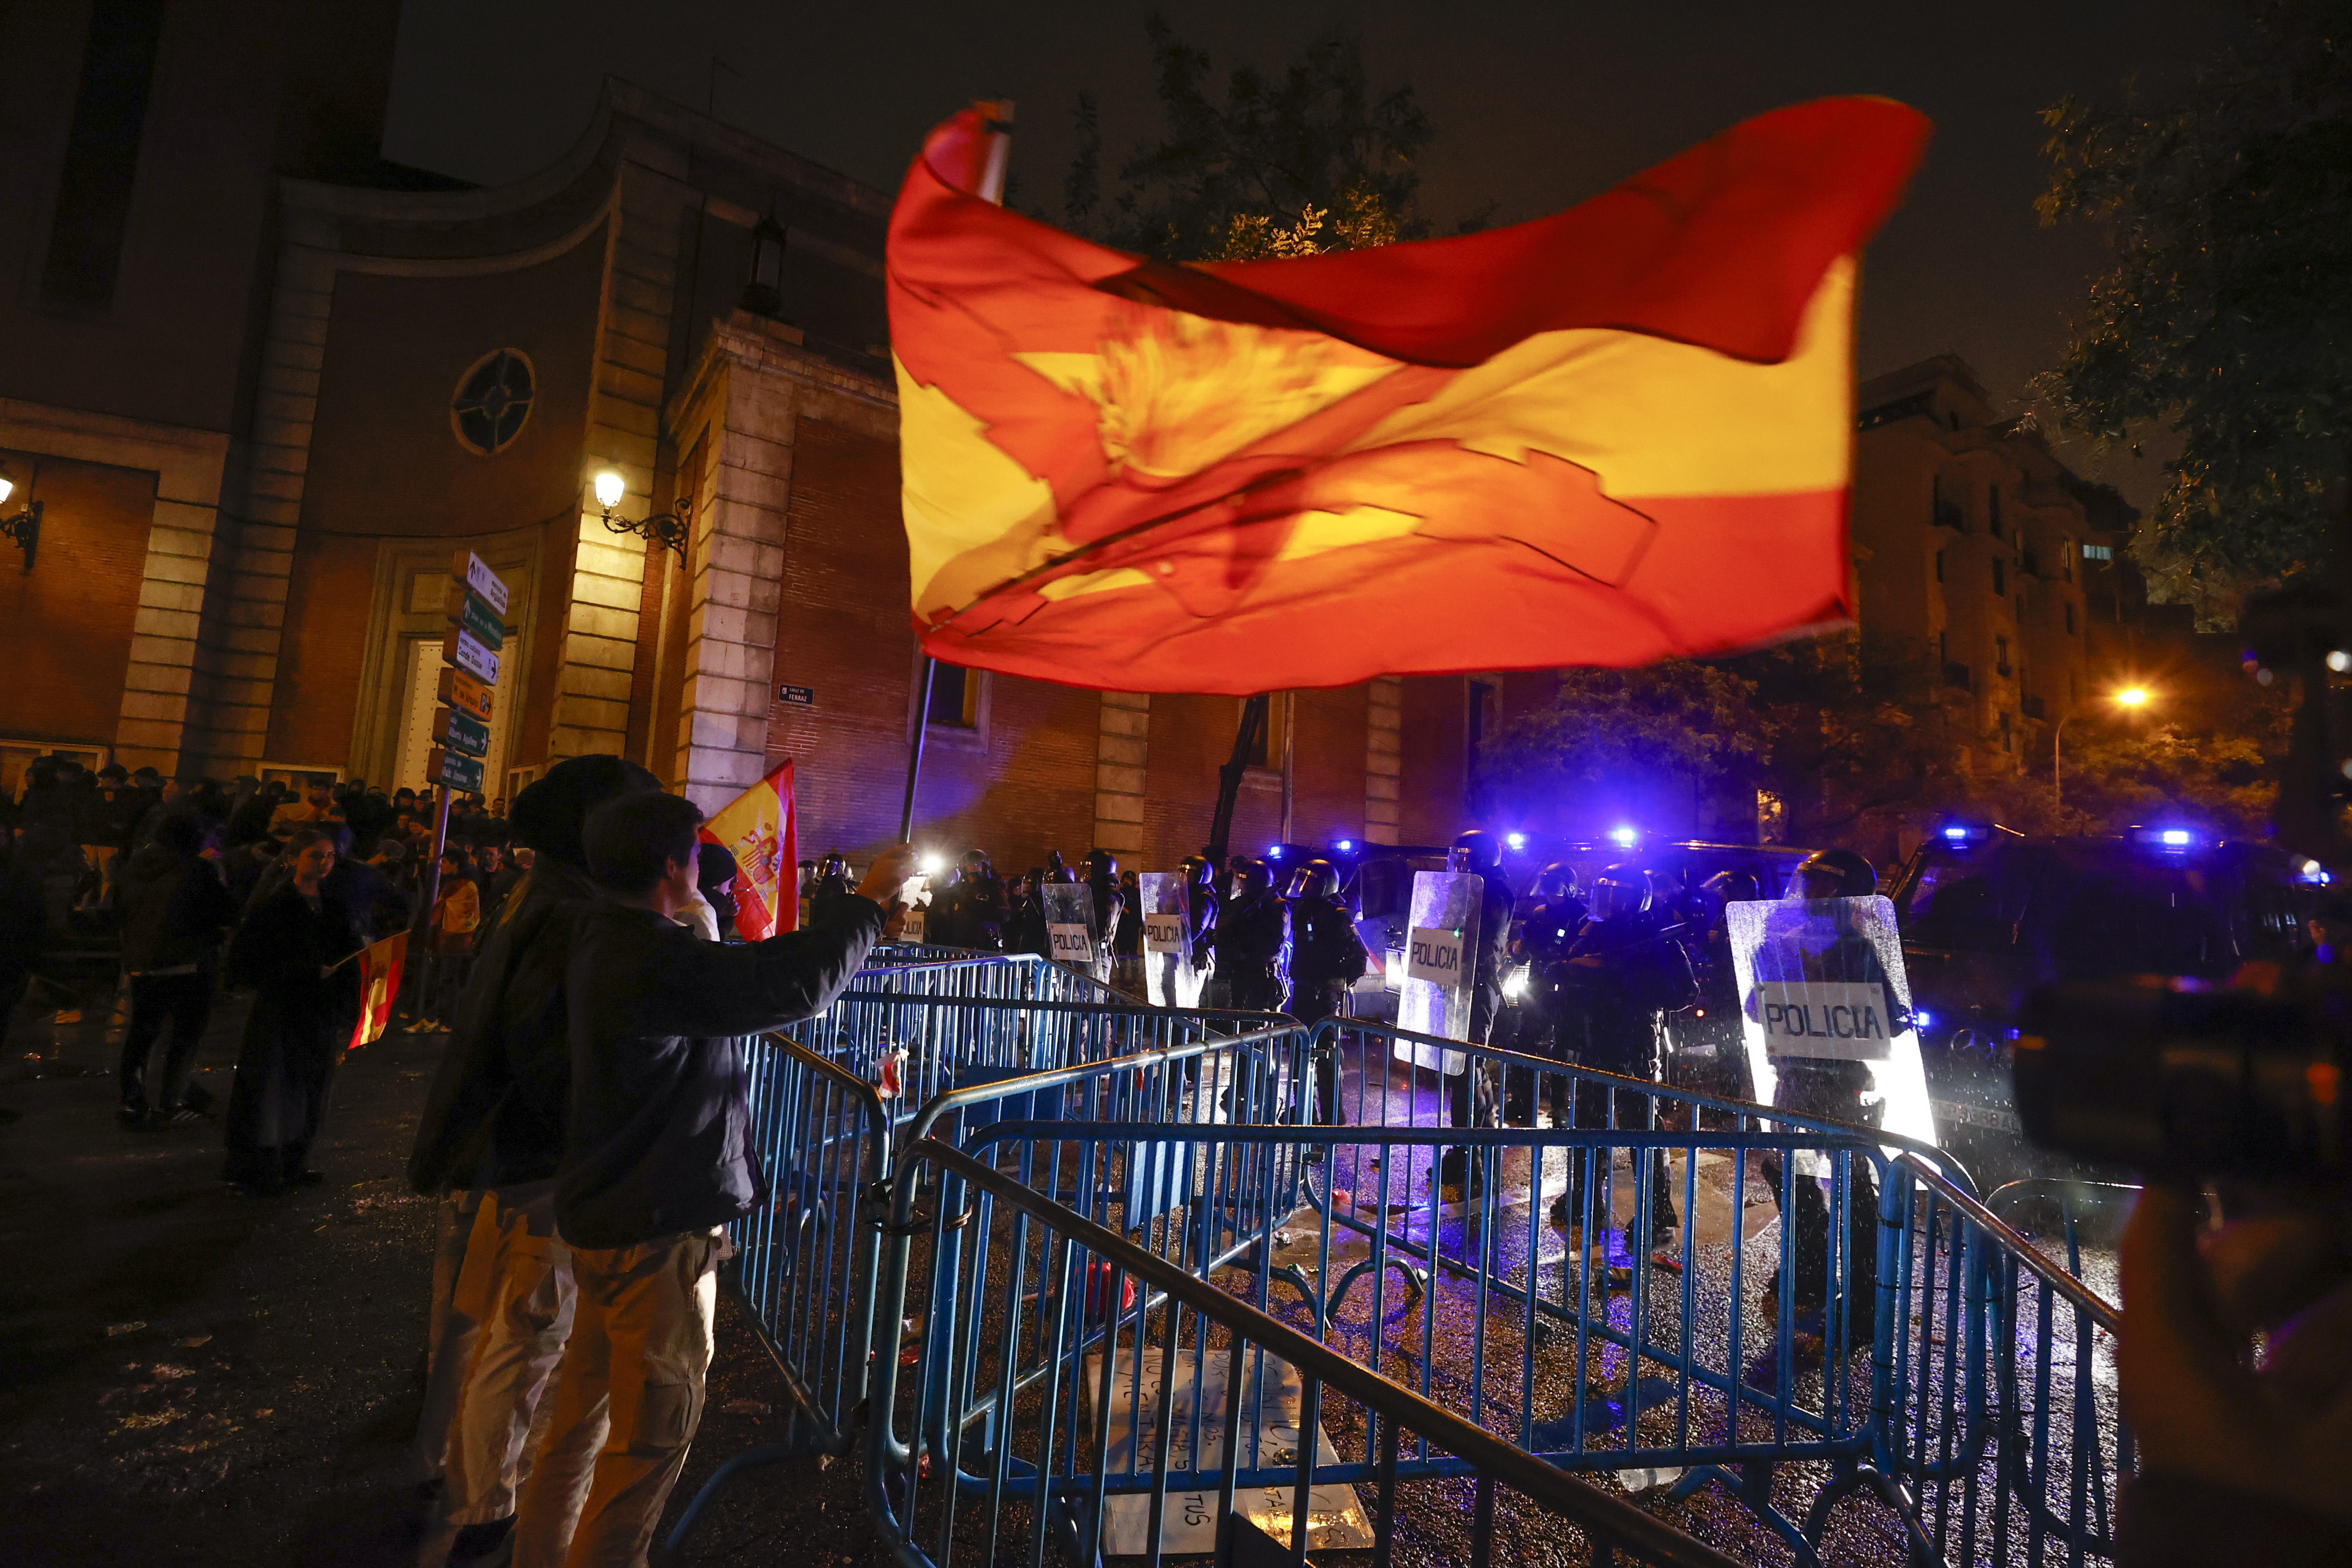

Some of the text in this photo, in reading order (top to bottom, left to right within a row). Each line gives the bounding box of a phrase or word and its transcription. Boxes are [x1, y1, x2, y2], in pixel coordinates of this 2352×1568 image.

[789, 694, 807, 702] FERRAZ
[1053, 934, 1088, 952] POLICIA
[1148, 925, 1179, 943] POLICIA
[1411, 941, 1458, 971] POLICIA
[1764, 1003, 1883, 1040] POLICIA
[1184, 1493, 1210, 1526] TUS
